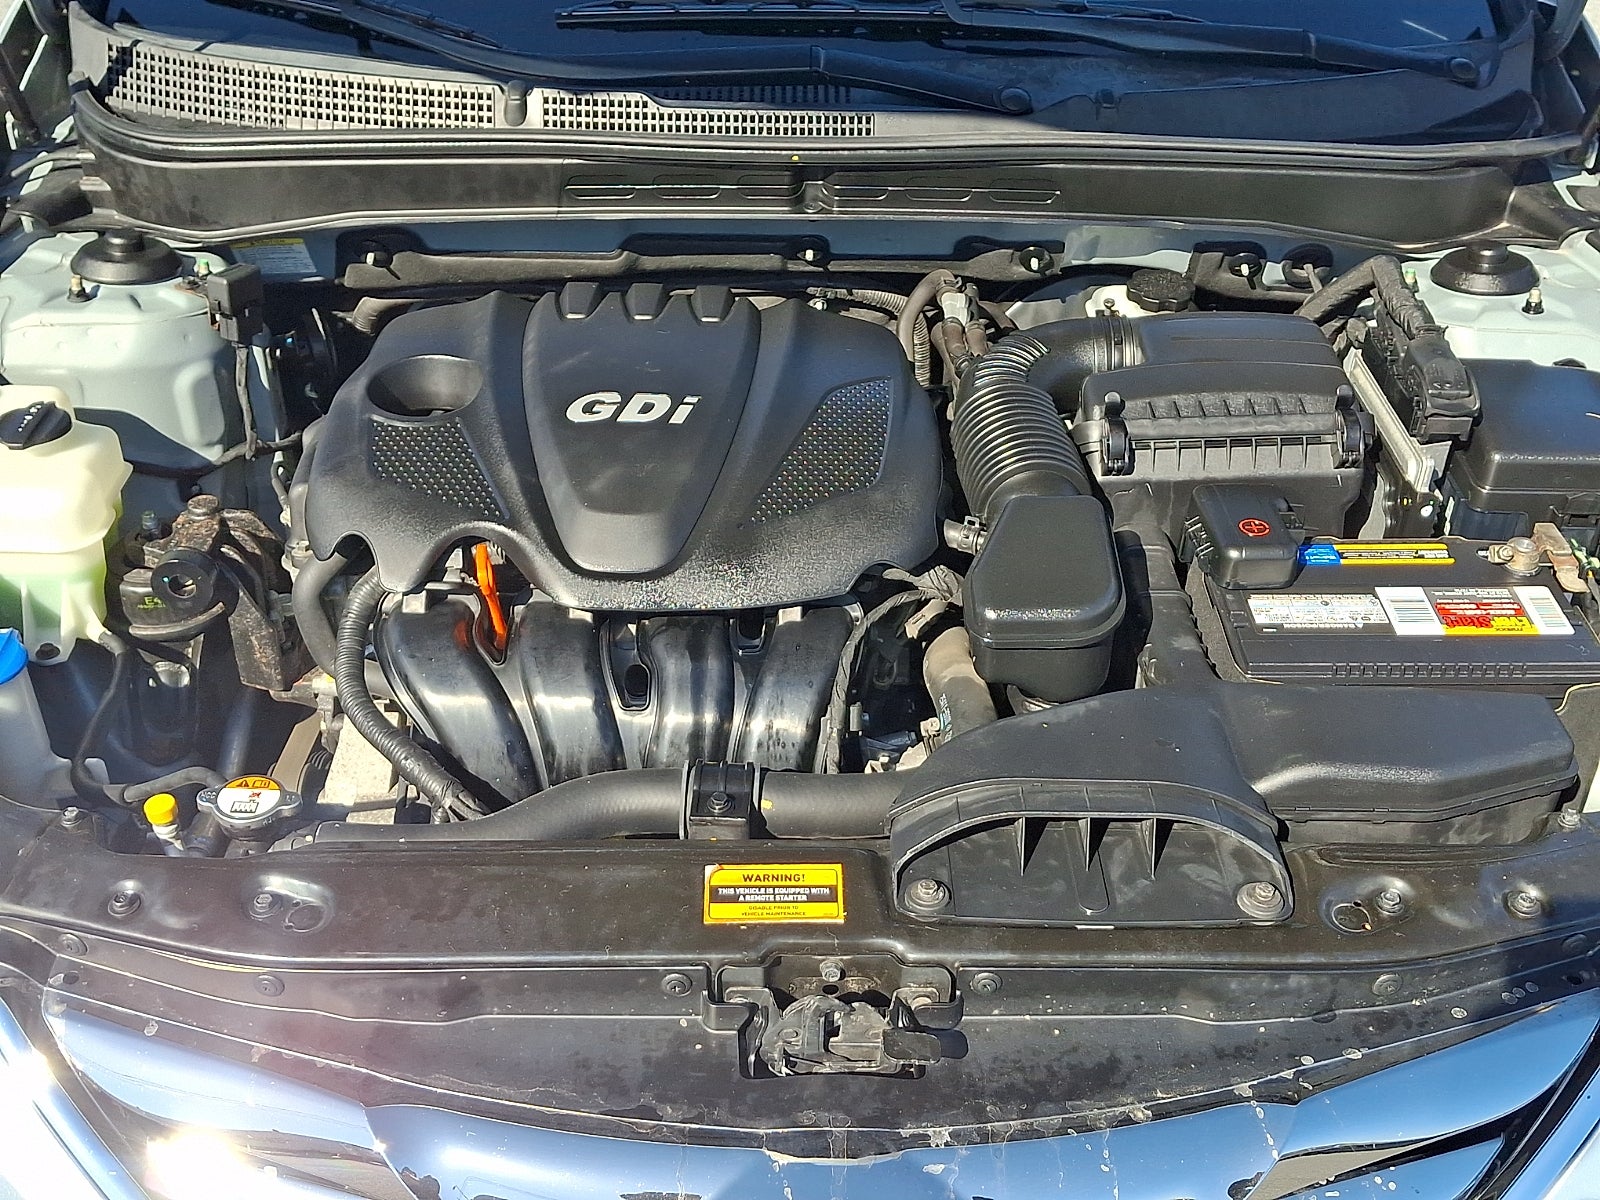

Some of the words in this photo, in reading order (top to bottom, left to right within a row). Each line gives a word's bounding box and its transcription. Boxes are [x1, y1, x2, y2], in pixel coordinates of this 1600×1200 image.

[566, 391, 701, 424] GDi
[742, 873, 806, 883] WARNING!
[718, 887, 735, 895] THIS
[735, 887, 766, 895] VEHICLE
[766, 887, 774, 895] IS
[774, 887, 810, 895] EQUIPPED
